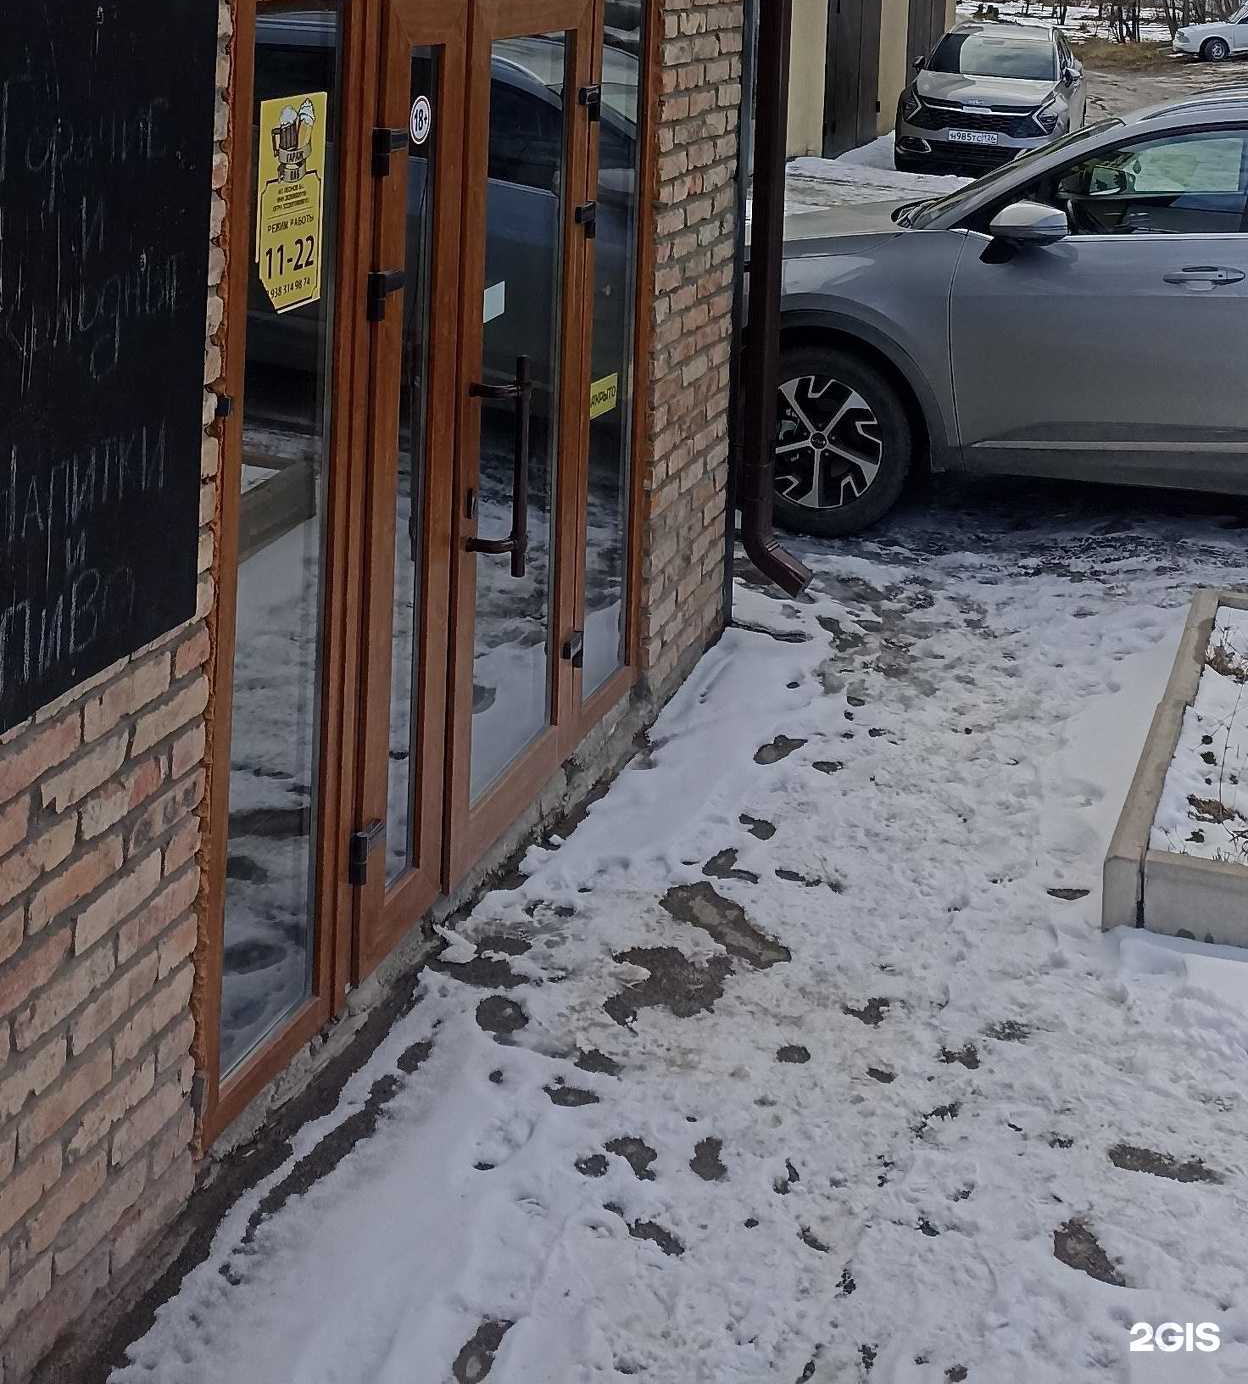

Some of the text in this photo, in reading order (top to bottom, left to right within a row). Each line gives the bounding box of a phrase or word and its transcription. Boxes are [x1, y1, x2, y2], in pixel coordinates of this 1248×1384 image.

[414, 108, 428, 132] 18+
[267, 214, 314, 234] РЕЖИМ РАБОТЫ
[265, 235, 315, 280] 11-22
[283, 282, 294, 295] 314
